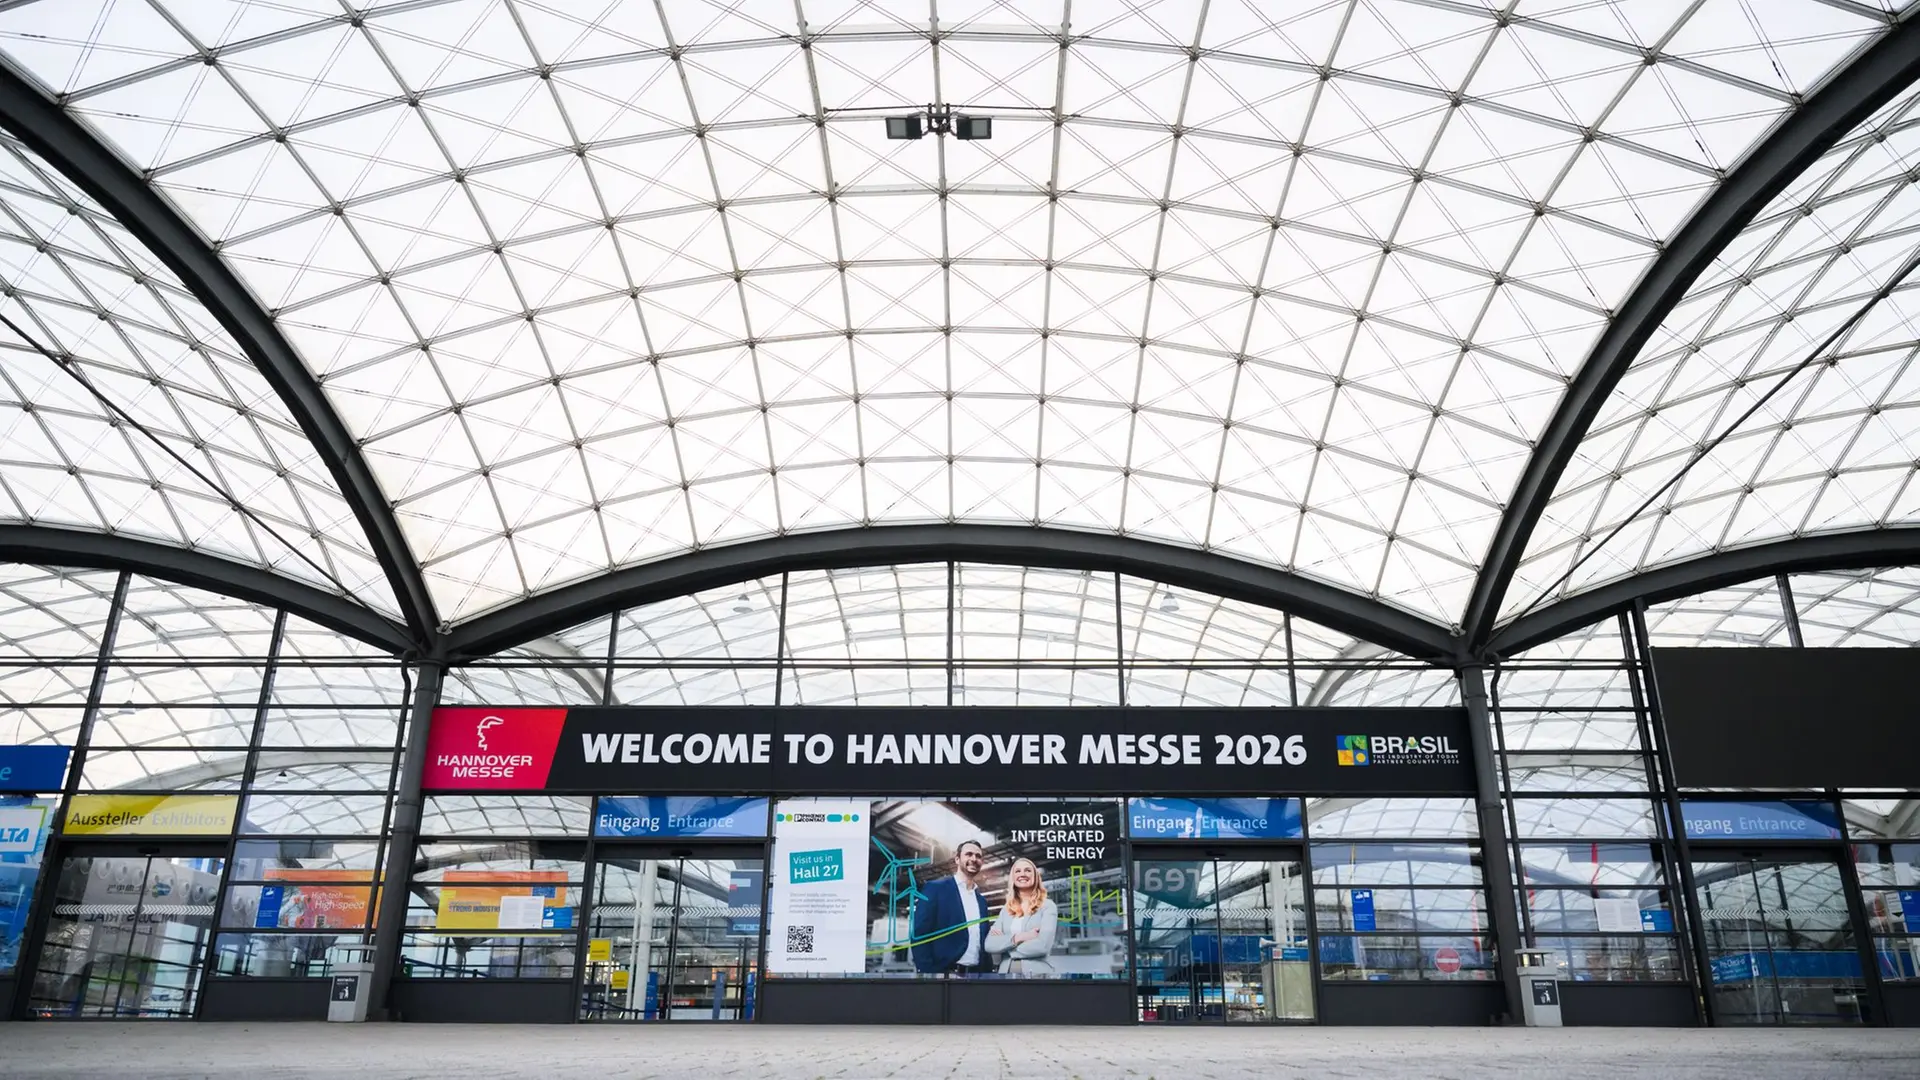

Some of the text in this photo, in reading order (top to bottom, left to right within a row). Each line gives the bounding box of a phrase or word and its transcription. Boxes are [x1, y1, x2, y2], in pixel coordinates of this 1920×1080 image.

[582, 733, 1308, 765] WELCOME TO HANNOVER MESSE 2026
[1371, 736, 1458, 754] BRASIL
[437, 755, 532, 766] HANNOVER
[452, 767, 514, 778] MESSE
[70, 811, 227, 827] Aussteller Exhibitors
[599, 814, 734, 832] Eingang Entrance
[1039, 813, 1105, 826] DRIVING
[1133, 815, 1268, 833] Eingang Entrance
[1684, 817, 1807, 834] ngang Entrance
[1011, 830, 1105, 843] INTEGRATED
[793, 854, 833, 865] Visit us in
[1046, 847, 1105, 860] ENERGY
[794, 865, 839, 879] Hall 27
[315, 901, 365, 911] High-speed
